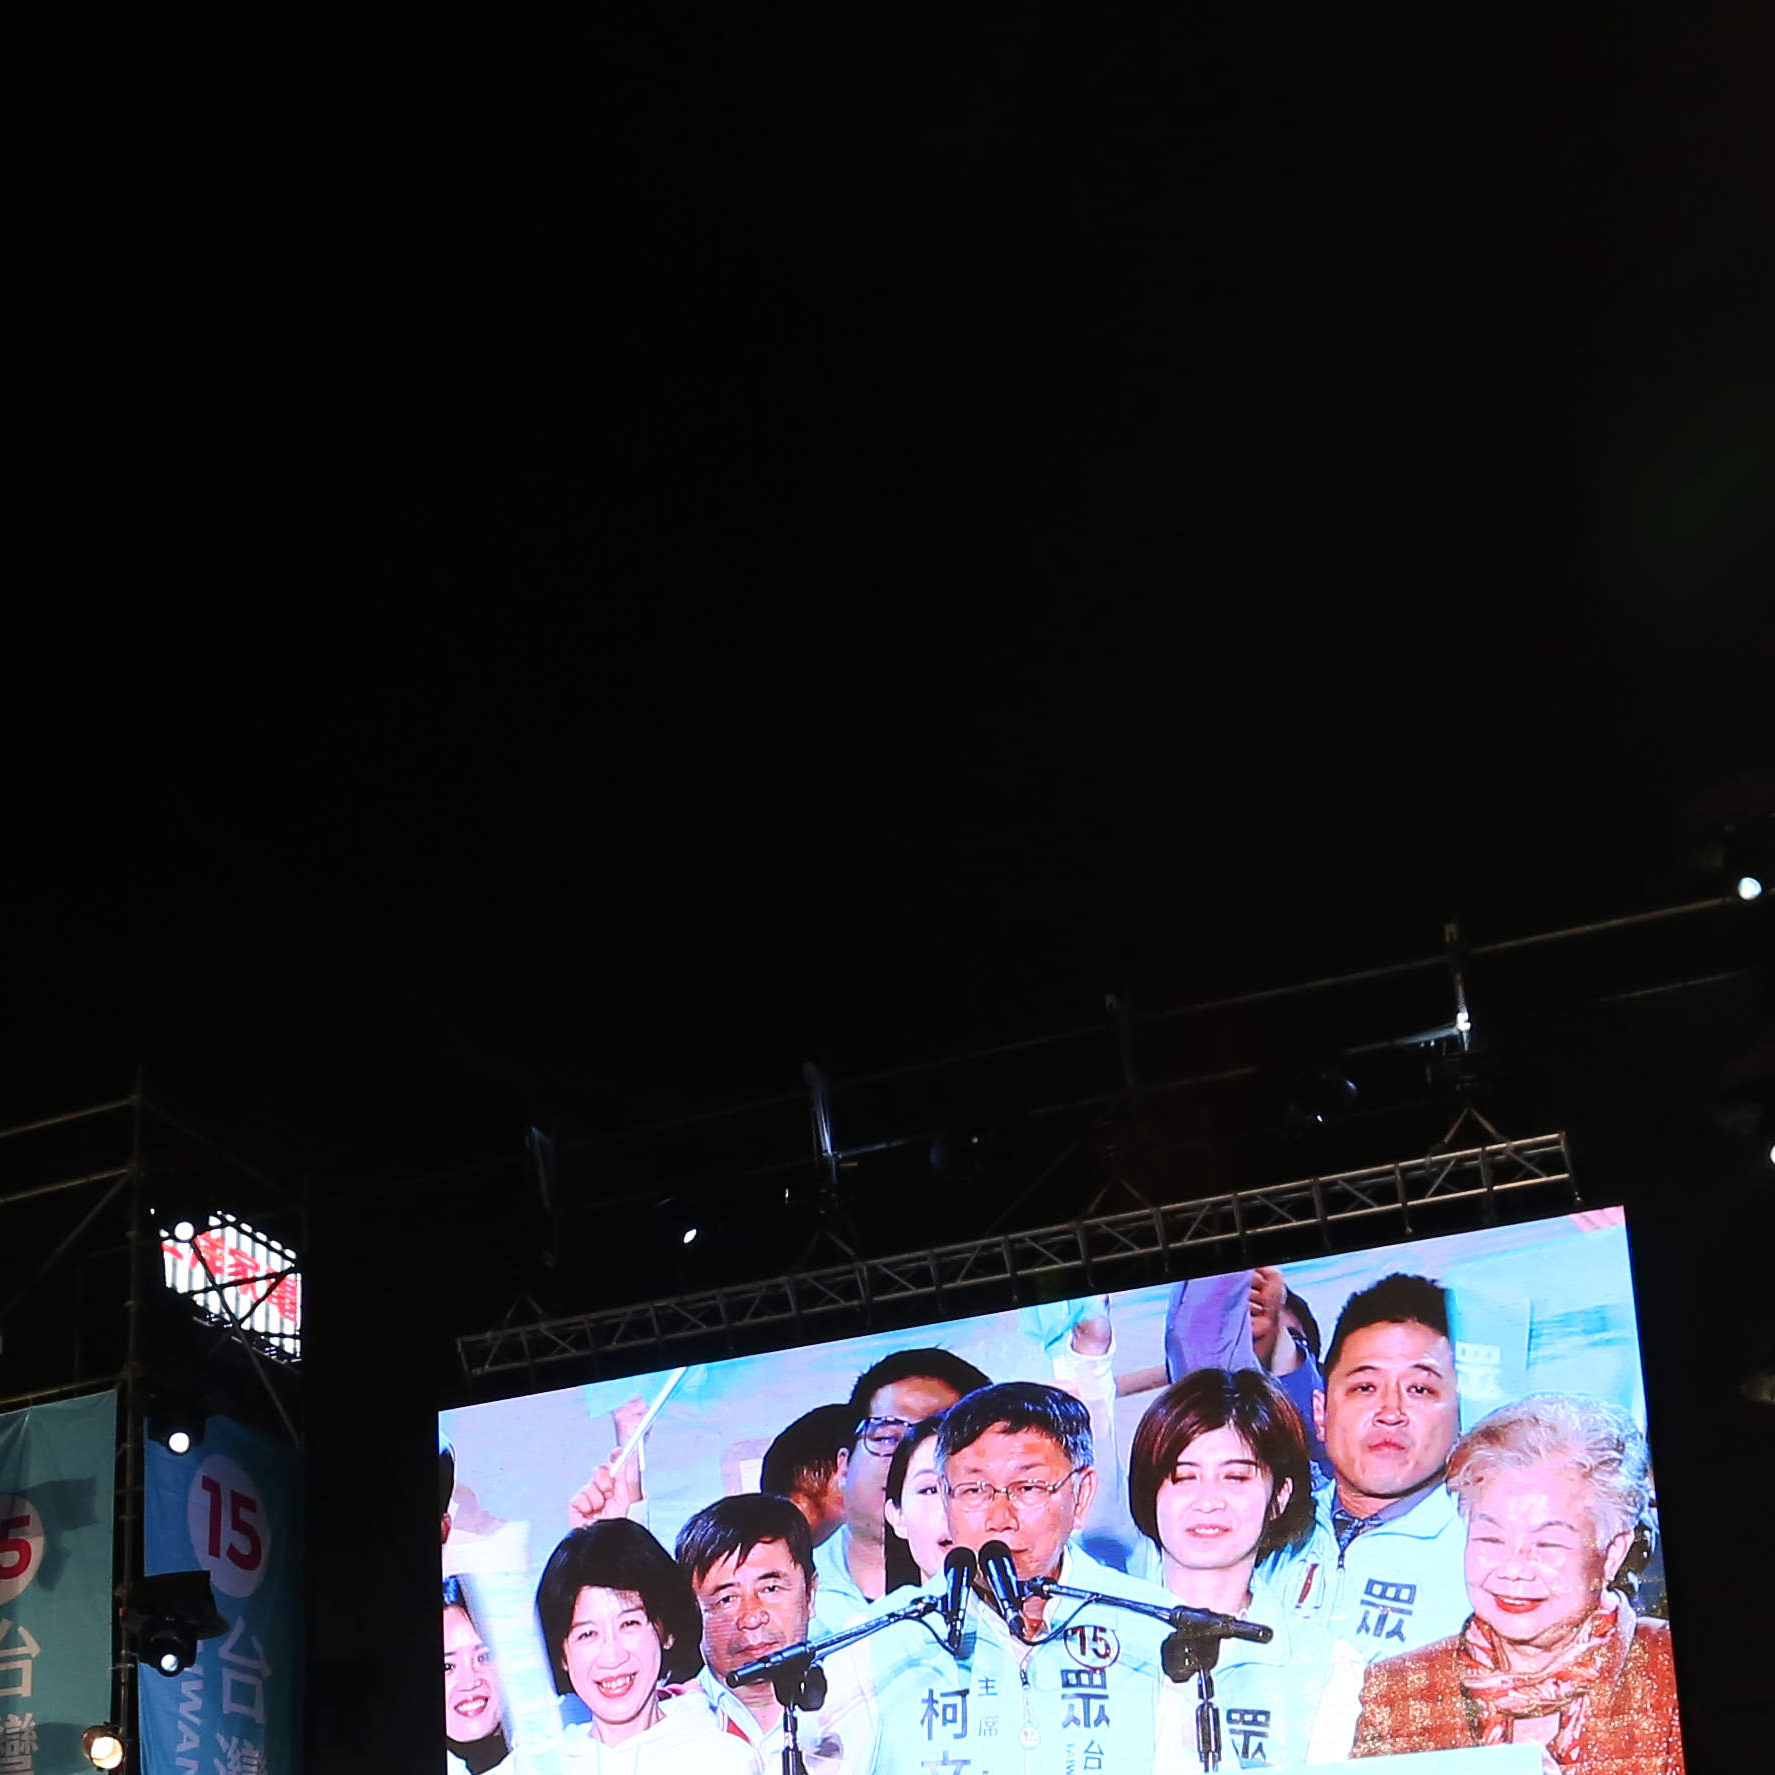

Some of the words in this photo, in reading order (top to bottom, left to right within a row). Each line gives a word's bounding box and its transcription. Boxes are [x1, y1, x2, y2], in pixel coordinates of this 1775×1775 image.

[201, 1476, 263, 1572] 15
[1356, 1577, 1418, 1644] 眾
[1075, 1626, 1113, 1660] 15
[977, 1675, 1000, 1738] 主席
[1061, 1668, 1111, 1729] 眾
[1226, 1708, 1271, 1760] 眾
